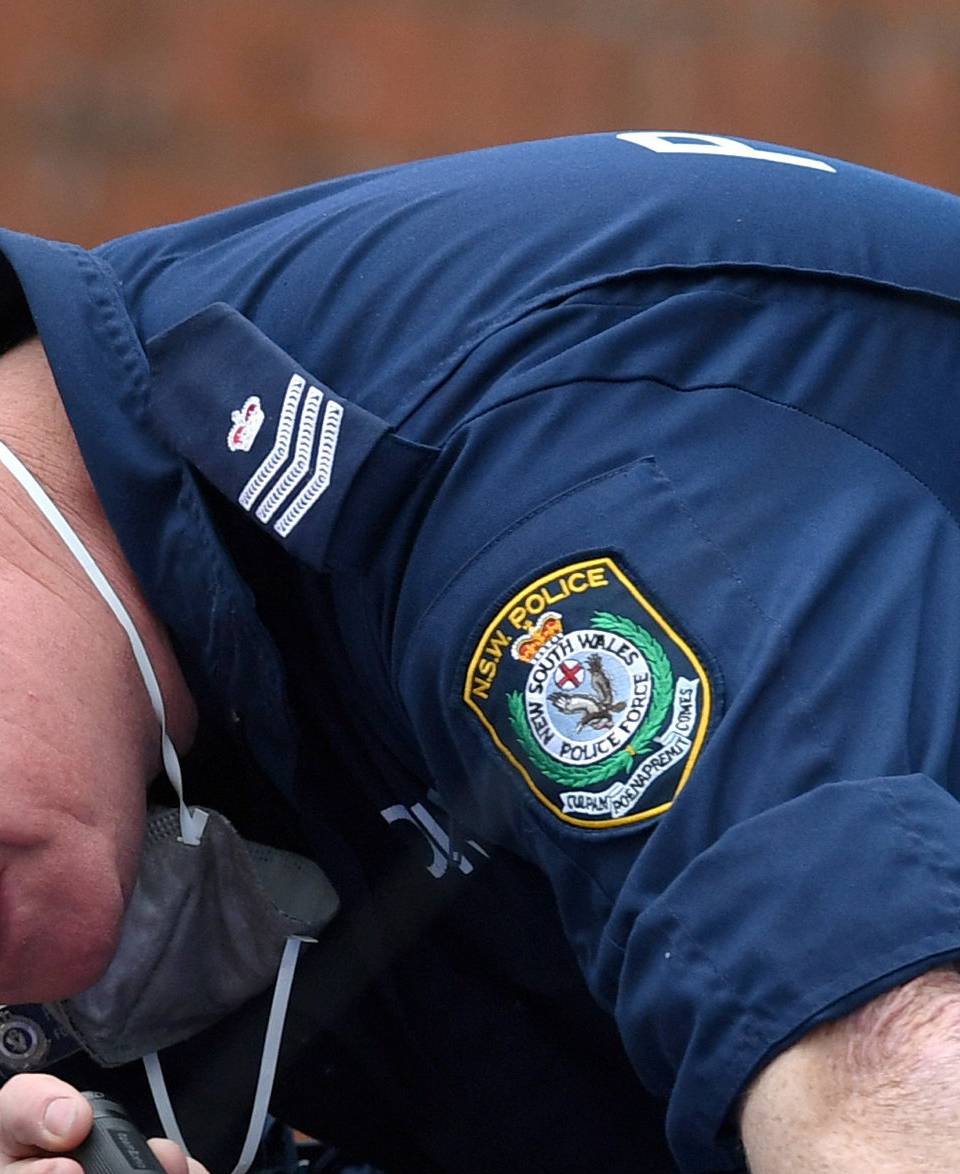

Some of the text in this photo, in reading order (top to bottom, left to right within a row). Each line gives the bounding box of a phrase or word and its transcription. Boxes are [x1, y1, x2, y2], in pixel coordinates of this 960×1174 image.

[508, 566, 608, 630] POLICE
[528, 633, 639, 745] NEW SOUTH WALES
[560, 672, 649, 761] POLICE FORCE
[676, 688, 694, 730] COMES
